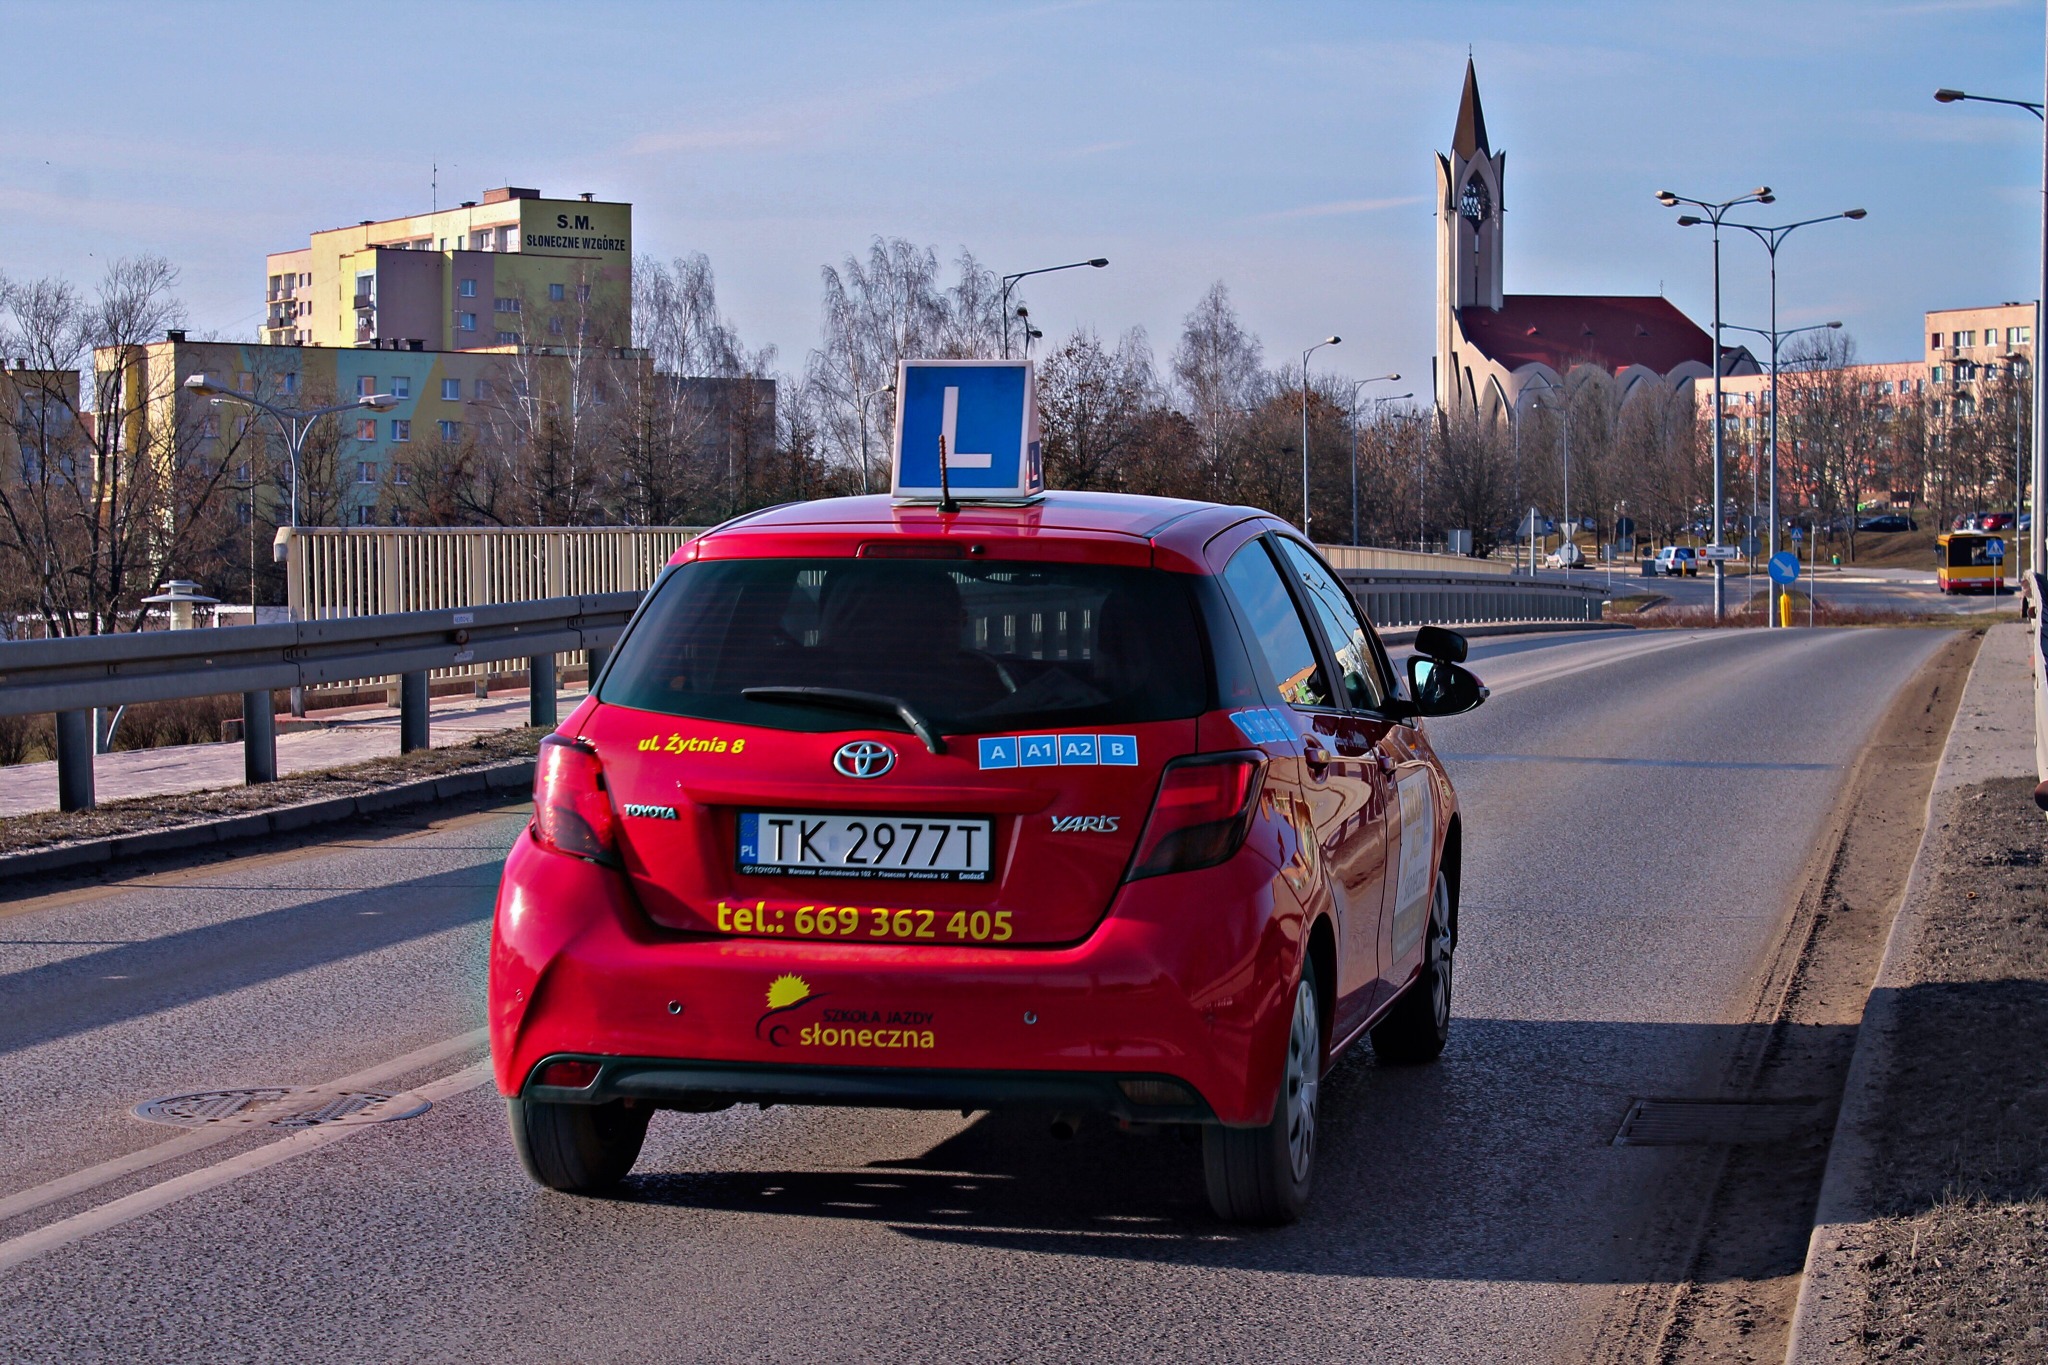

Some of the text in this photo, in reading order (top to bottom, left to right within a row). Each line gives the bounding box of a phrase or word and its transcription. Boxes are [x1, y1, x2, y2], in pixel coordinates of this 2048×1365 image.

[557, 214, 594, 230] S.M.
[527, 234, 626, 251] SŁONECZNE WZGÓRZE
[941, 386, 992, 468] L
[638, 733, 745, 754] ul. Żytnia 8
[990, 742, 1125, 760] A A1 A2 B
[623, 803, 676, 819] TOYOTA
[740, 845, 756, 857] PL
[768, 819, 982, 867] TK 2977T
[754, 866, 782, 874] TOYOTA
[788, 867, 816, 875] Warszawa
[717, 901, 1013, 941] tel.: 669 362 405
[822, 1008, 934, 1025] SZKOŁA JAZDY
[799, 1021, 935, 1049] słoneczna
